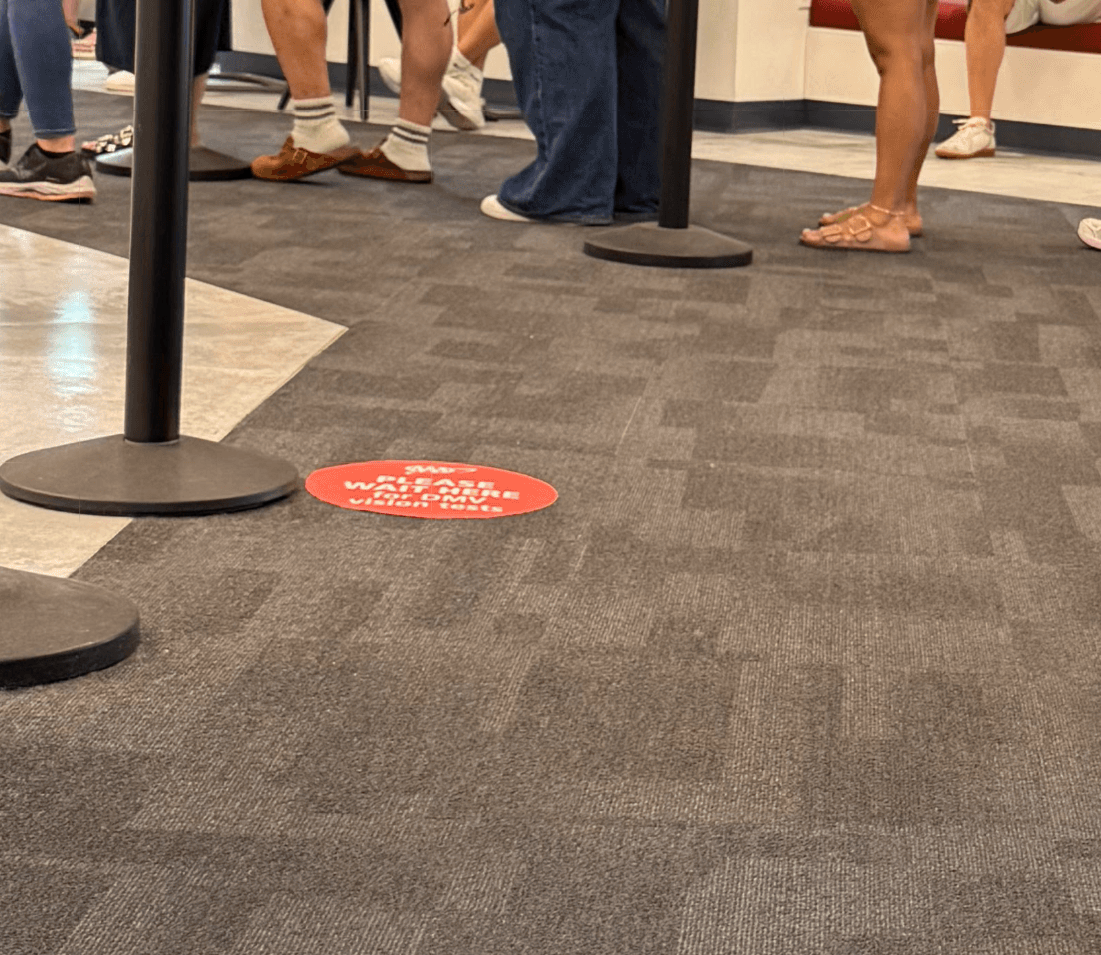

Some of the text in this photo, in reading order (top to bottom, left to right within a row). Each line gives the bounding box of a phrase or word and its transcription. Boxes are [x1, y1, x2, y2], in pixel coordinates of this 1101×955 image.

[376, 475, 495, 489] PLEASE
[344, 481, 520, 500] WAIT HERE
[373, 491, 487, 504] for DMV
[349, 498, 503, 512] vision tests
